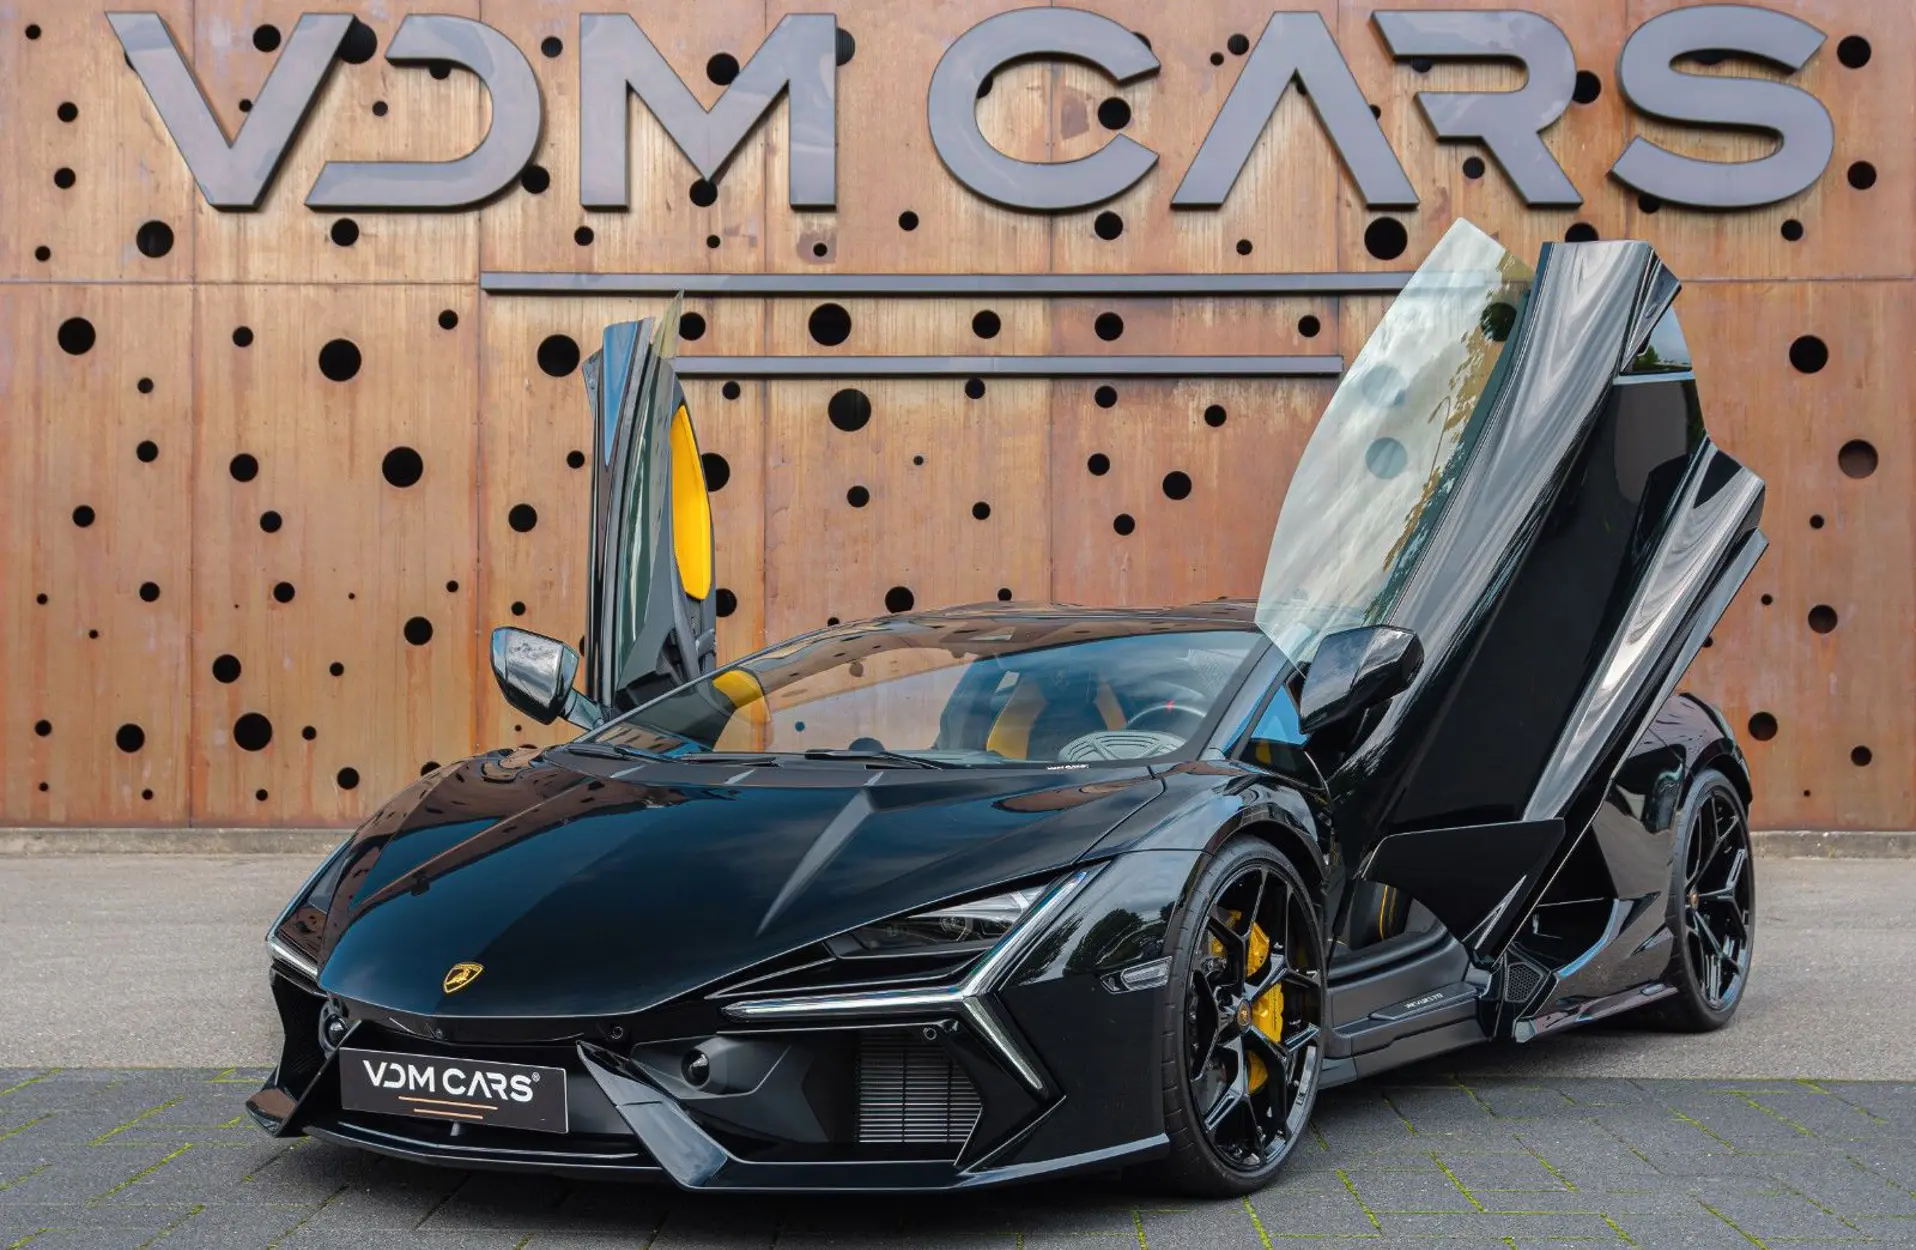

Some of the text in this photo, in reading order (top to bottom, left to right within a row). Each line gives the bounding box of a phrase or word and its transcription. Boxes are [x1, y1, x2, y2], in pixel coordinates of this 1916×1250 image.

[104, 5, 1835, 211] VDM CARS
[362, 1059, 436, 1093] VDM
